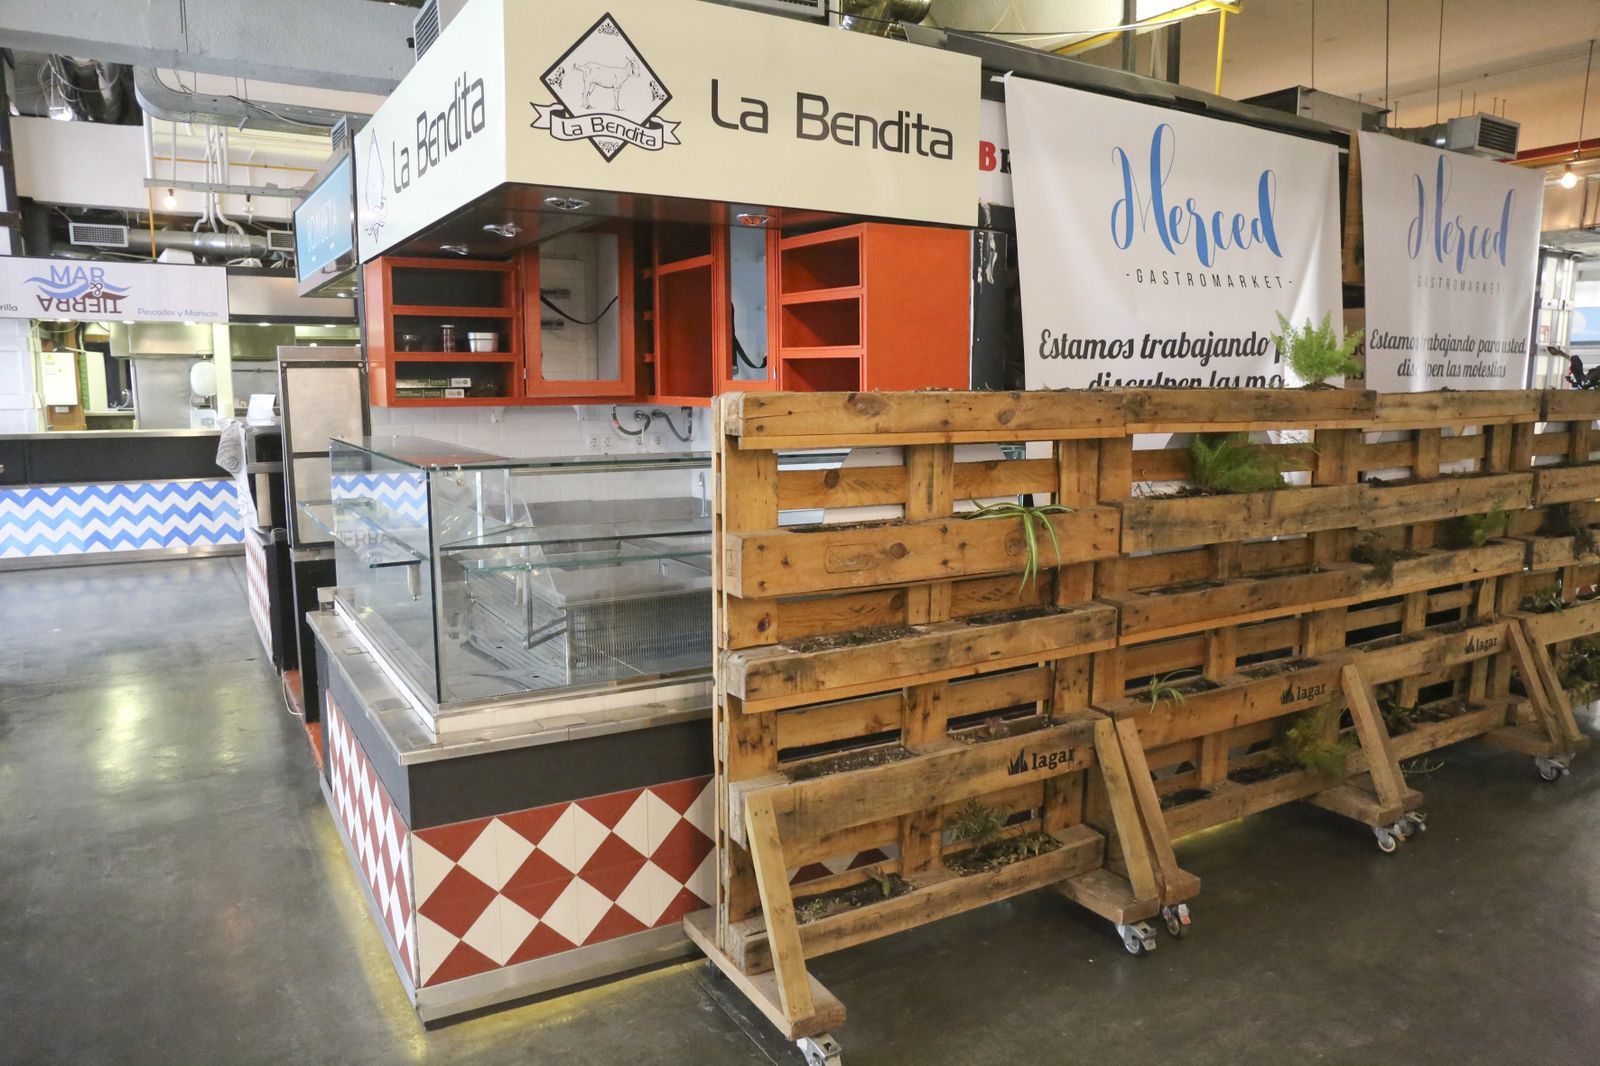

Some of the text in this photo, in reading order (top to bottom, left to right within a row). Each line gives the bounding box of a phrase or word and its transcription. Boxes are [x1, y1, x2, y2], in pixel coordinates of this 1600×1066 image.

[711, 78, 954, 161] La Bendita
[393, 71, 486, 194] La Bendita
[562, 117, 656, 147] La Bendita
[1110, 123, 1283, 268] Merced
[1407, 154, 1516, 275] Merced
[50, 264, 106, 285] MAR
[36, 294, 122, 314] TIERRA
[137, 307, 219, 319] Pescados y Mariscos
[1039, 329, 1134, 360] Estamos
[1140, 330, 1271, 367] trabajando
[1446, 359, 1462, 378] las
[1476, 637, 1498, 652] lagar
[1296, 683, 1327, 701] lagar
[1031, 747, 1076, 770] lagar
